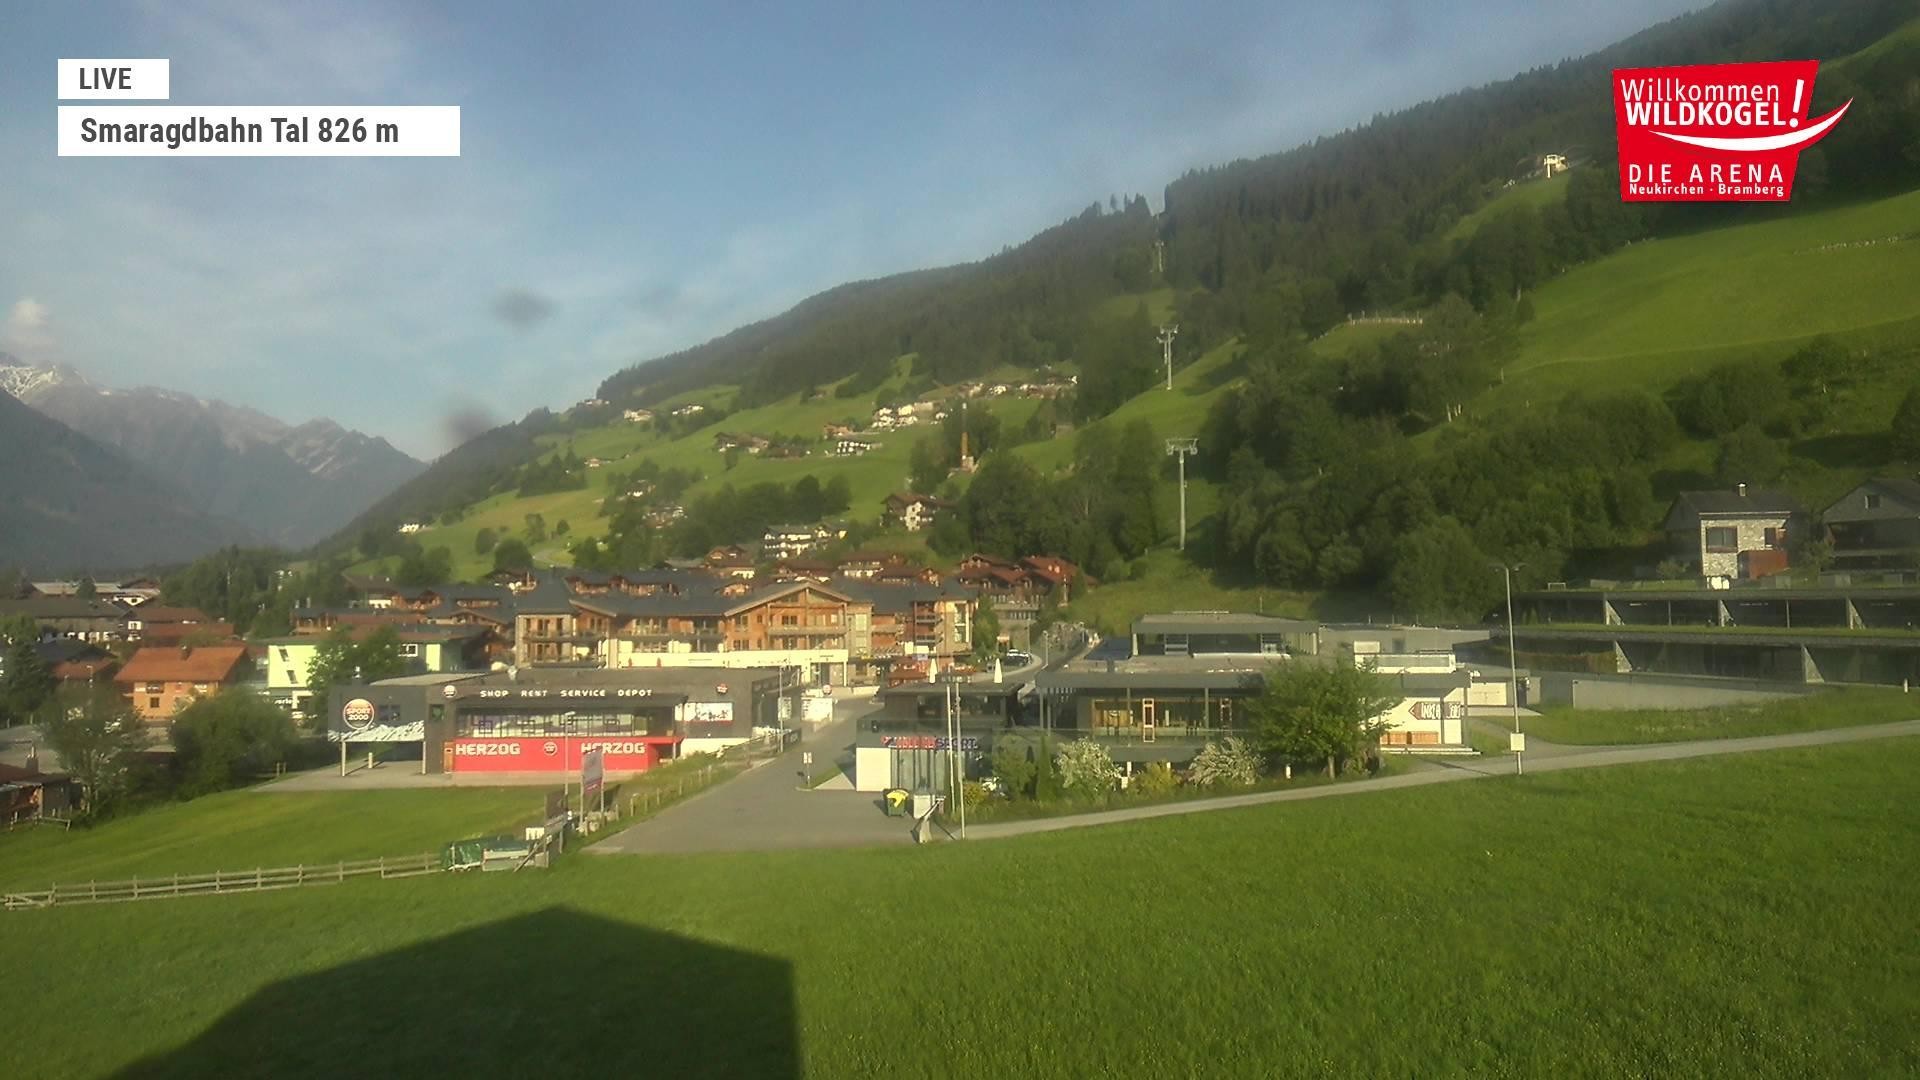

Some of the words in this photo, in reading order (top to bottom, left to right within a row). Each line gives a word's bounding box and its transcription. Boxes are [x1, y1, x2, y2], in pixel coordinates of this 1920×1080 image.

[479, 690, 510, 698] SHOP
[559, 689, 606, 697] SERVICE
[617, 689, 652, 697] DEPOT
[346, 706, 369, 714] SPORT
[347, 713, 369, 721] 2000
[455, 743, 521, 756] HERZOG
[581, 742, 645, 755] HERZOG
